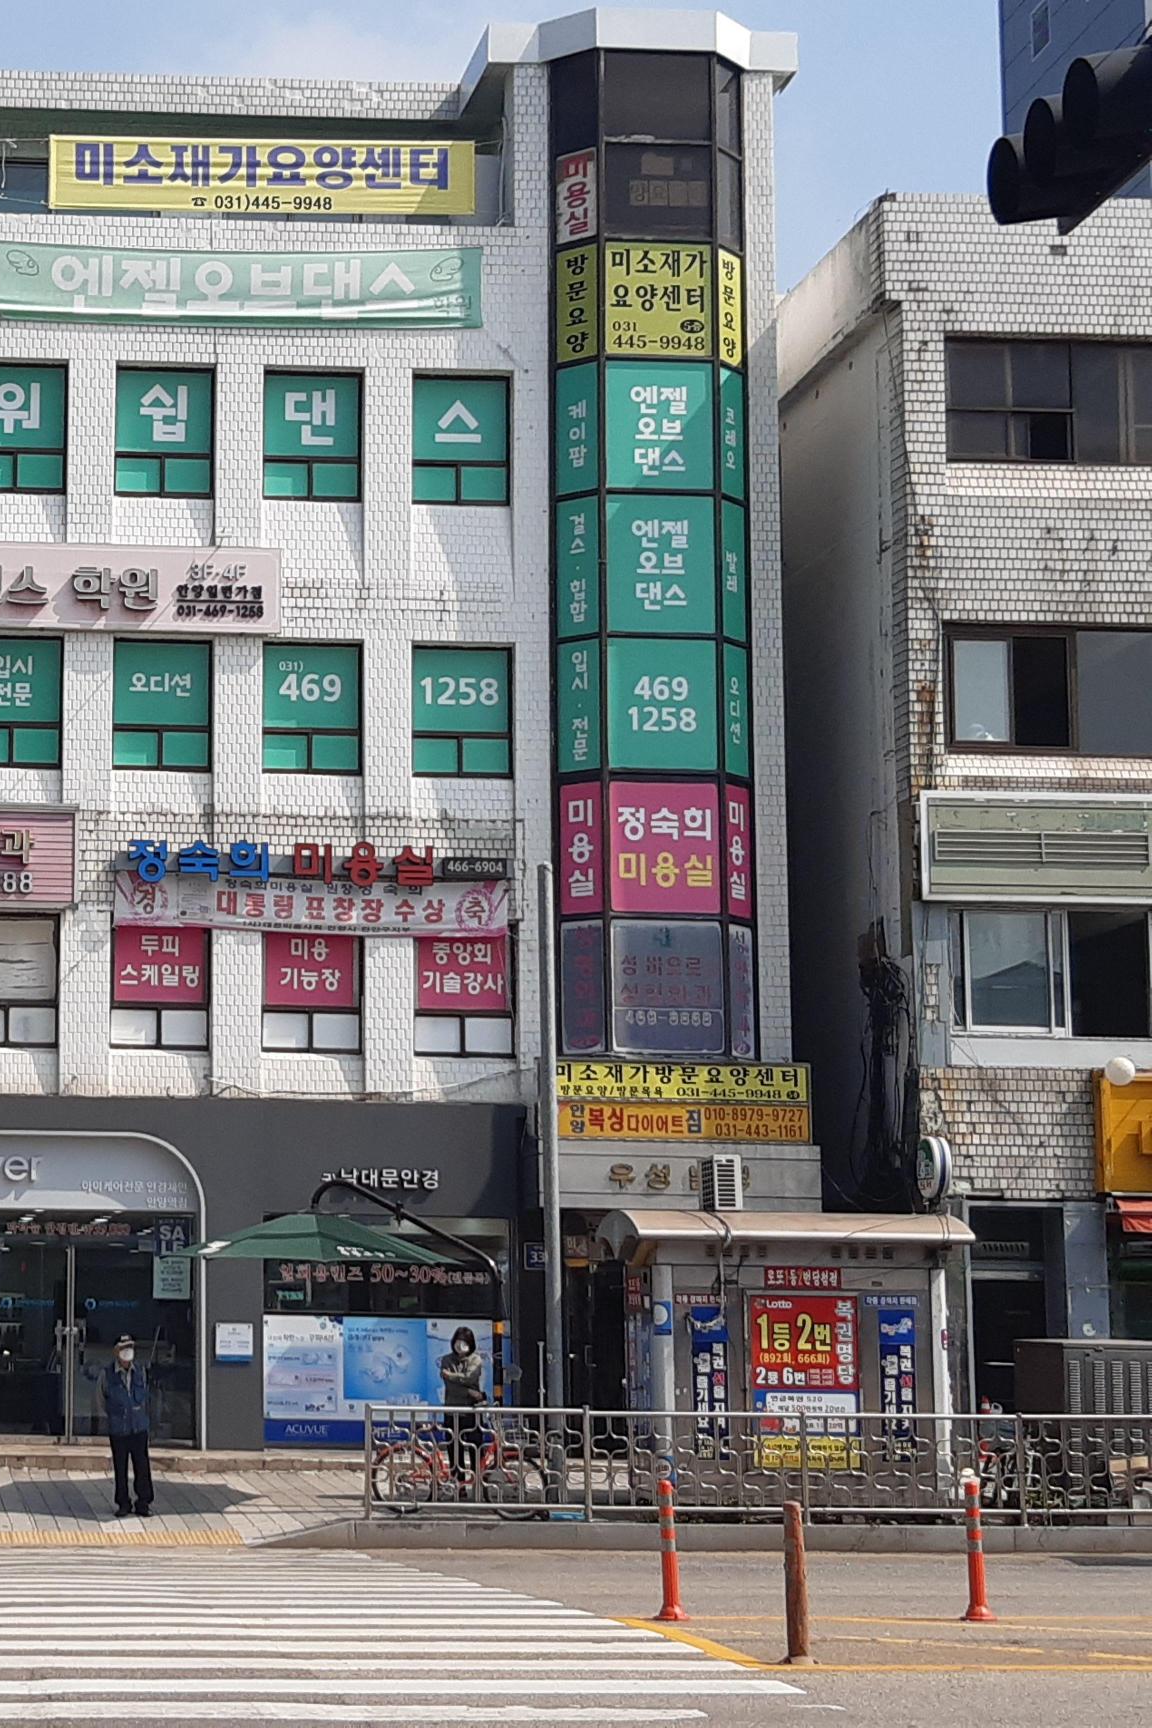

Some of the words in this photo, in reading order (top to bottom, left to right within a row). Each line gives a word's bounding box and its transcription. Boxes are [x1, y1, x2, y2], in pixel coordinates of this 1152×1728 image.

[75, 143, 449, 190] 미소재가요양센터
[214, 194, 333, 211] 031)445-9948
[563, 156, 590, 235] 미용실
[611, 249, 707, 278] 미소재가
[51, 255, 418, 319] 엔젤오브댄스
[610, 284, 705, 313] 요양센터
[566, 254, 589, 353] 방문요양
[723, 259, 736, 358] 방문요양
[612, 321, 637, 331] 031
[612, 335, 705, 350] 445-9948
[630, 385, 687, 414] 엔젤
[567, 400, 587, 468] 케이팝
[635, 418, 683, 440] 오브
[634, 447, 686, 476] 댄스
[631, 519, 688, 548] 엔젤
[636, 552, 685, 575] 오브
[726, 551, 738, 593] 발레
[72, 564, 160, 612] 학원
[635, 581, 687, 610] 댄스
[176, 604, 264, 618] 031-469-1258
[278, 660, 304, 673] 031)
[128, 671, 192, 698] 오디션
[278, 673, 341, 703] 469
[419, 676, 499, 706] 1258
[634, 676, 688, 701] 469
[628, 706, 697, 732] 1258
[617, 807, 712, 841] 정숙희
[127, 839, 270, 883] 정숙희
[294, 841, 435, 886] 미용실
[568, 799, 594, 897] 미용실
[729, 801, 746, 900] 미용실
[447, 858, 504, 874] 466-6904
[618, 852, 713, 887] 미용실
[216, 890, 294, 919] 대통령
[305, 896, 384, 923] 표창장
[394, 898, 446, 923] 수상
[464, 896, 486, 925] 축
[140, 934, 180, 956] 두피
[291, 938, 329, 961] 미용
[432, 942, 491, 965] 중앙회
[120, 963, 199, 988] 스케일링
[280, 967, 341, 992] 기능장
[423, 970, 504, 995] 기술강사
[556, 1063, 799, 1087] 미소재가방문요양센터
[677, 1087, 781, 1098] 031-445-9948
[588, 1107, 624, 1132] 복싱
[627, 1114, 684, 1133] 다이어트
[686, 1109, 702, 1133] 짐
[704, 1108, 804, 1123] 010-8979-9727
[715, 1124, 803, 1138] 031-443-1161
[766, 1300, 792, 1308] Lotto
[756, 1313, 790, 1350] 1등
[796, 1313, 831, 1351] 2번
[835, 1300, 855, 1385] 복권명당
[285, 1424, 328, 1434] ACUVUE
